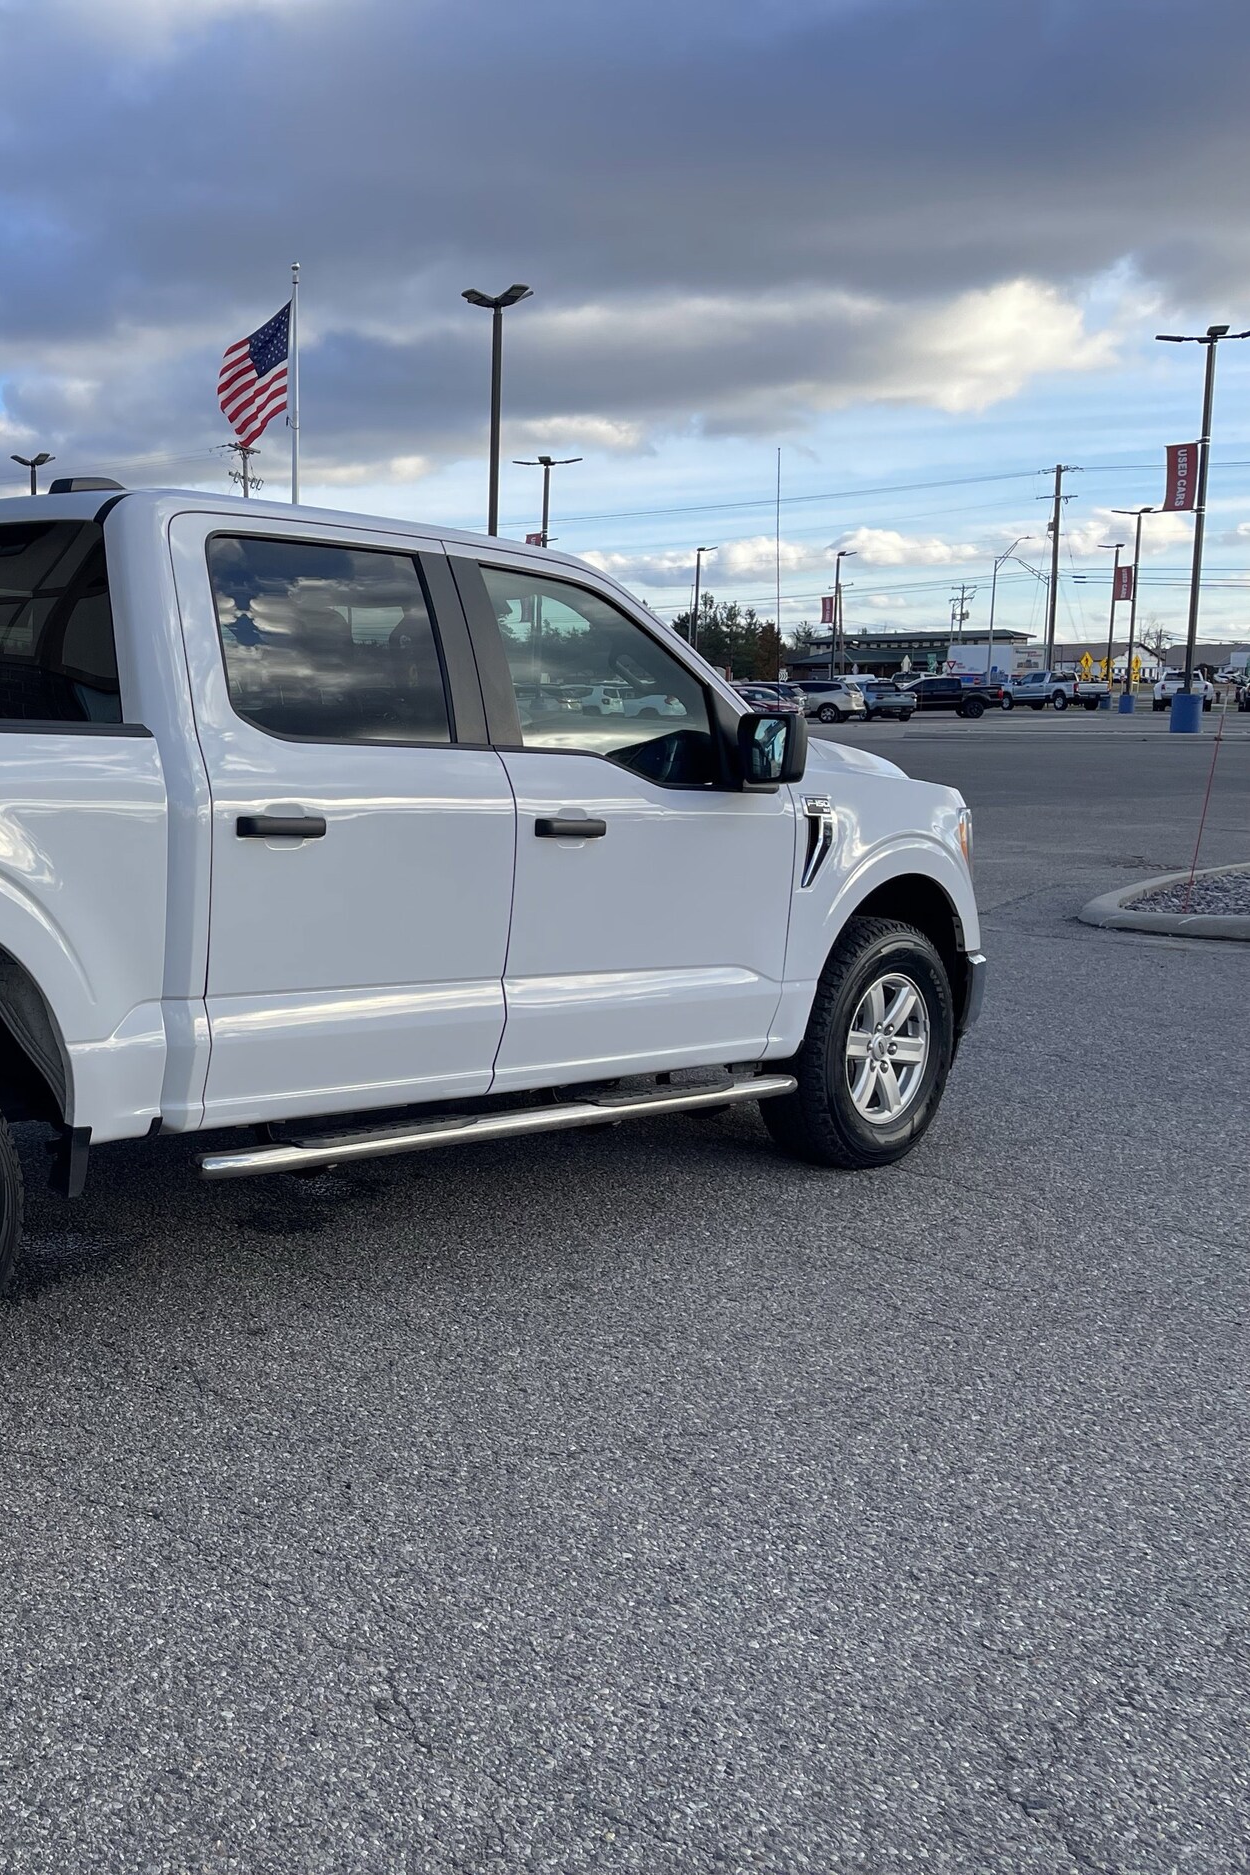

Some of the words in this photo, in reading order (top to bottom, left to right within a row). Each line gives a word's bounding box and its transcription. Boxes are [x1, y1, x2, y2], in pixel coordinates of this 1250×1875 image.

[1177, 449, 1187, 476] USED
[1175, 480, 1187, 507] CARS
[807, 799, 830, 808] F-150
